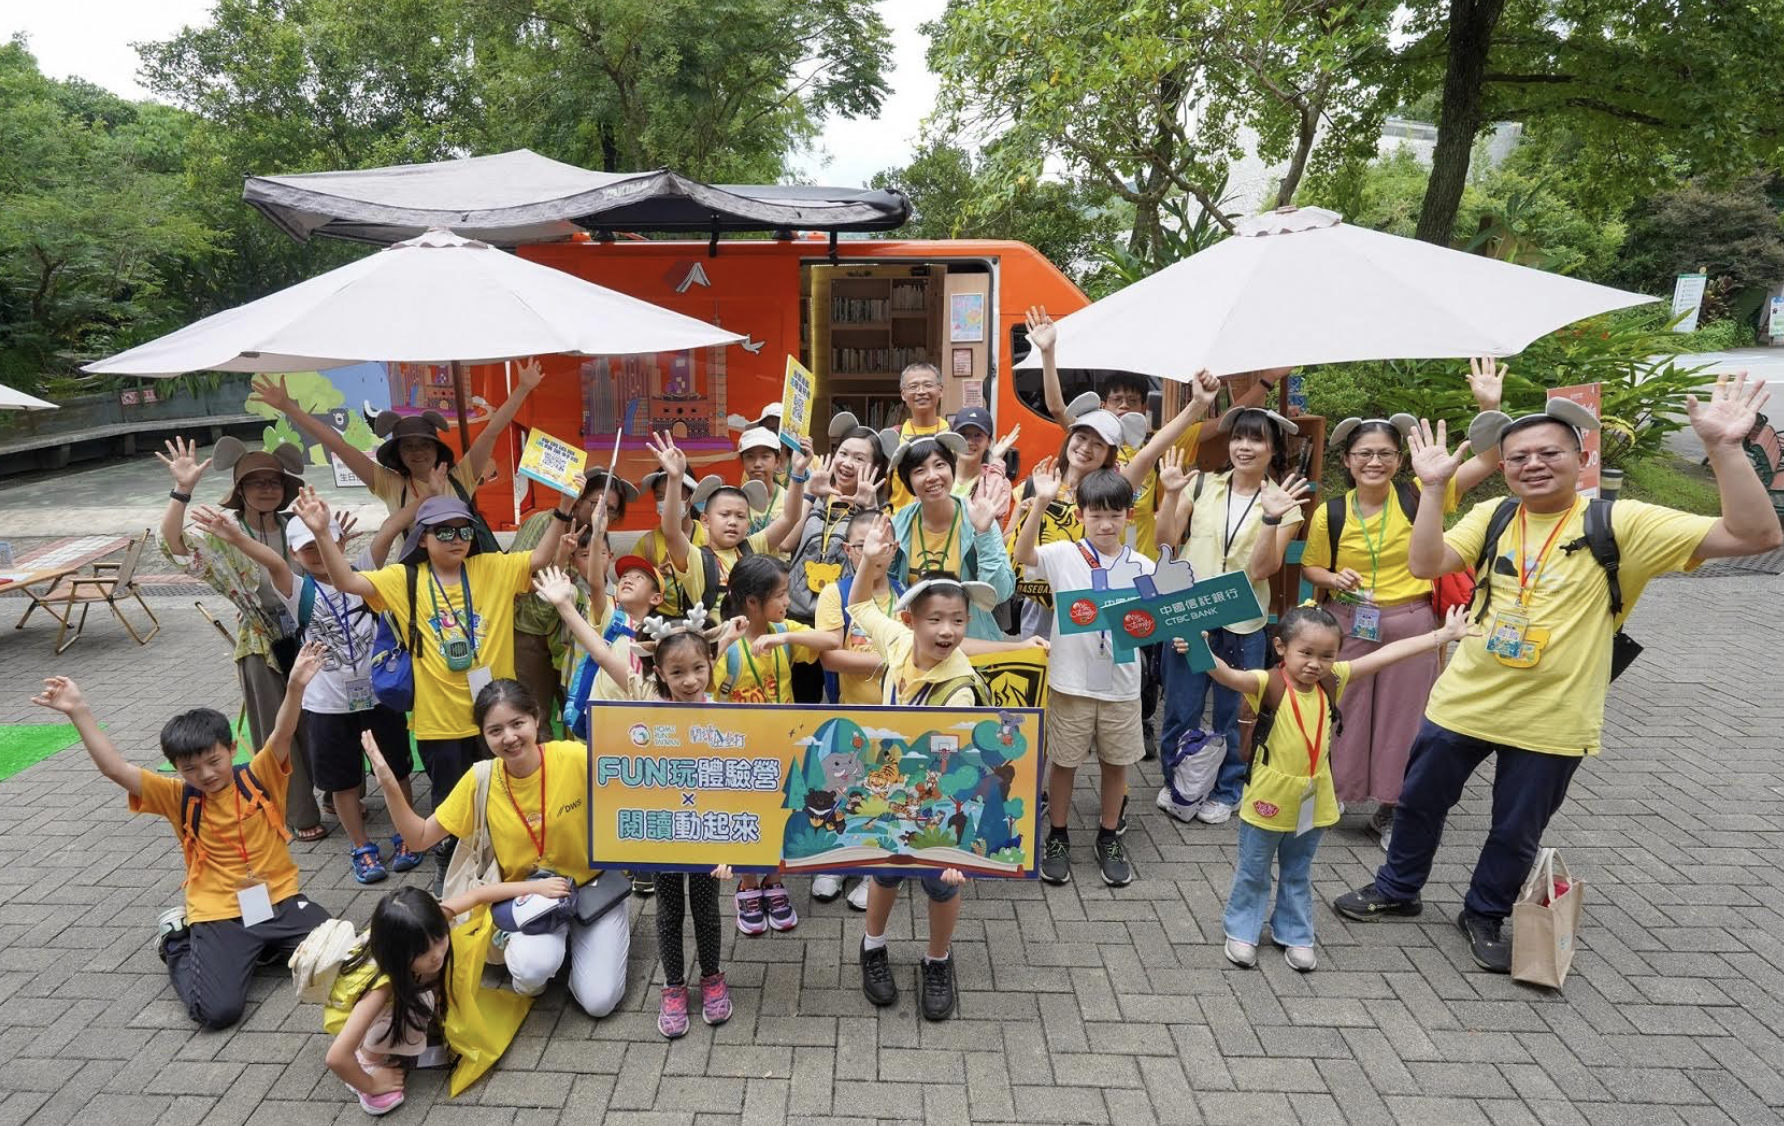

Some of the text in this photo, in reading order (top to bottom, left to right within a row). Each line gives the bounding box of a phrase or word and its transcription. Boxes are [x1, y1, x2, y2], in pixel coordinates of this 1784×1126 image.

[1160, 588, 1239, 615] 中國信託銀行
[1165, 607, 1218, 626] CTBC BANK
[598, 756, 780, 789] FUN玩體驗營
[618, 809, 760, 842] 閱讀動起來
